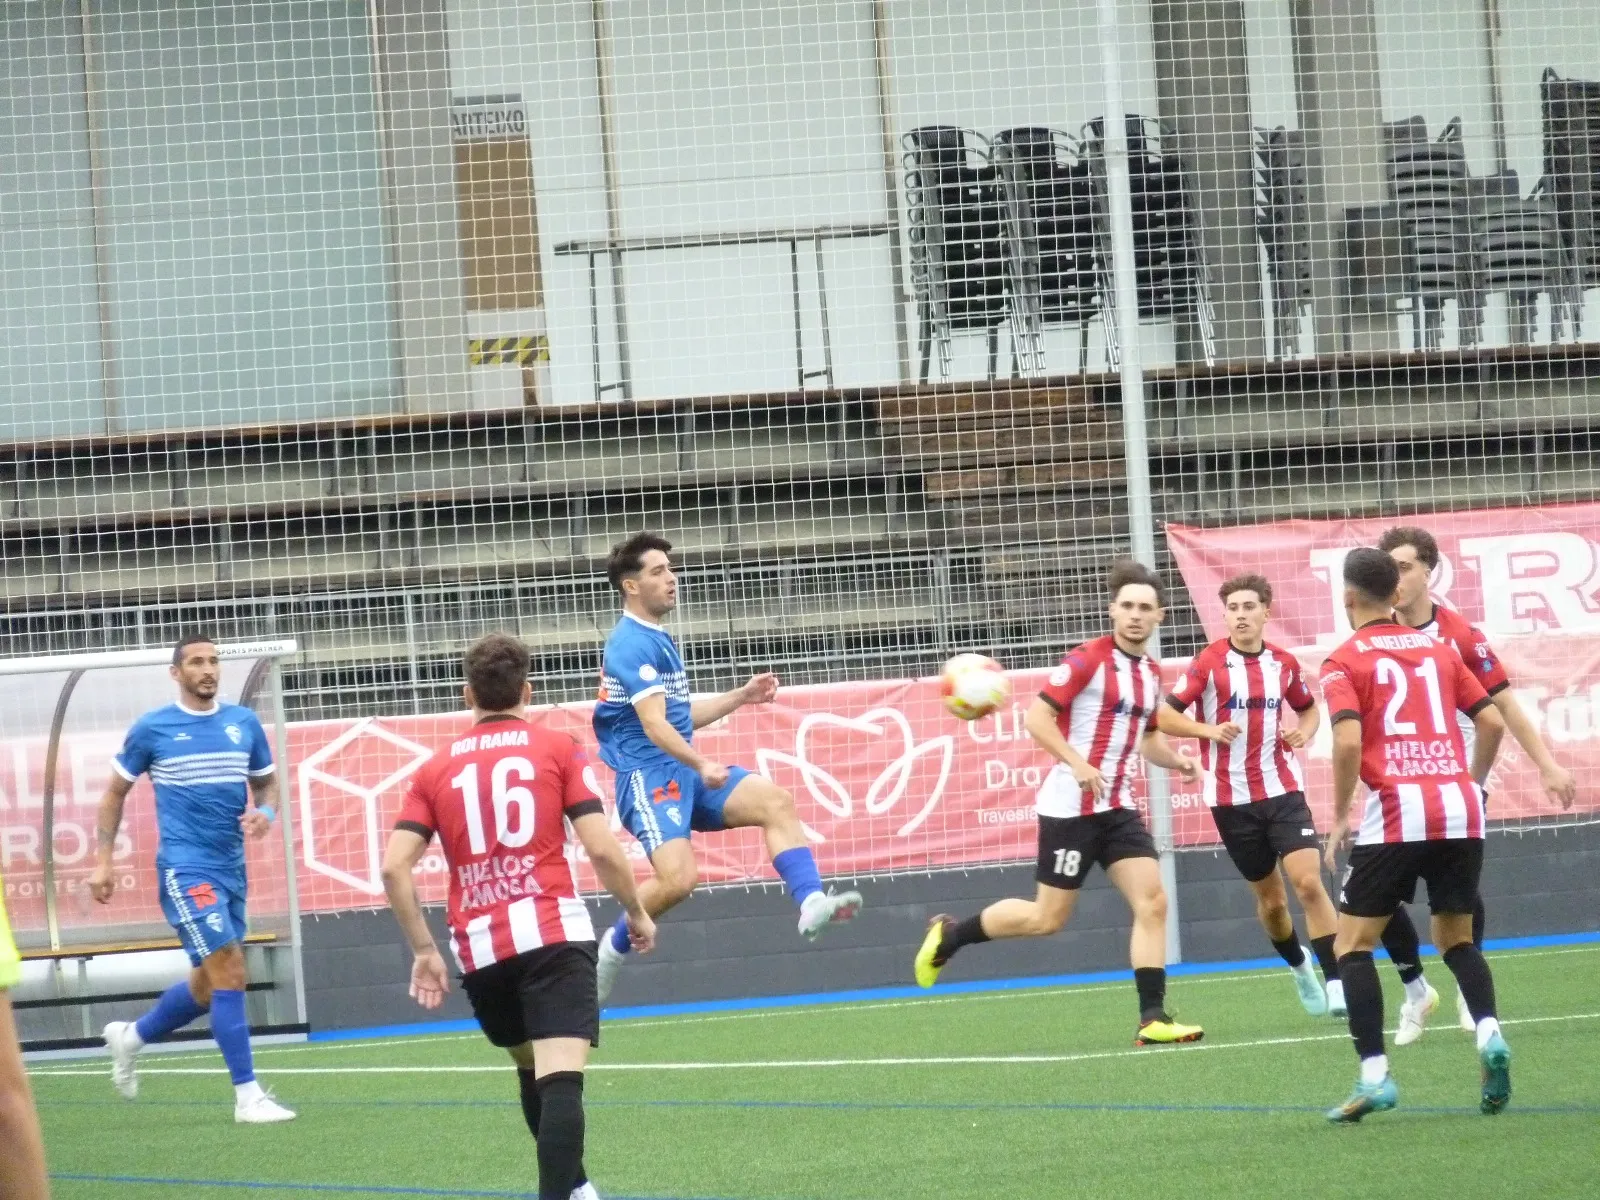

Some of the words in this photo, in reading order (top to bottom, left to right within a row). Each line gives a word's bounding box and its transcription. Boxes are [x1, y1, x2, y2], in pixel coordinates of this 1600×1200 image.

[216, 647, 246, 656] SPORTS
[1376, 656, 1448, 736] 21
[450, 736, 477, 757] ROI
[480, 730, 529, 751] RAMA
[1384, 738, 1455, 760] HIELOS
[1384, 759, 1464, 777] AMOSA
[451, 756, 535, 855] 16
[457, 854, 536, 888] HIELOS
[1053, 848, 1082, 877] 18
[459, 875, 544, 913] AMOSA
